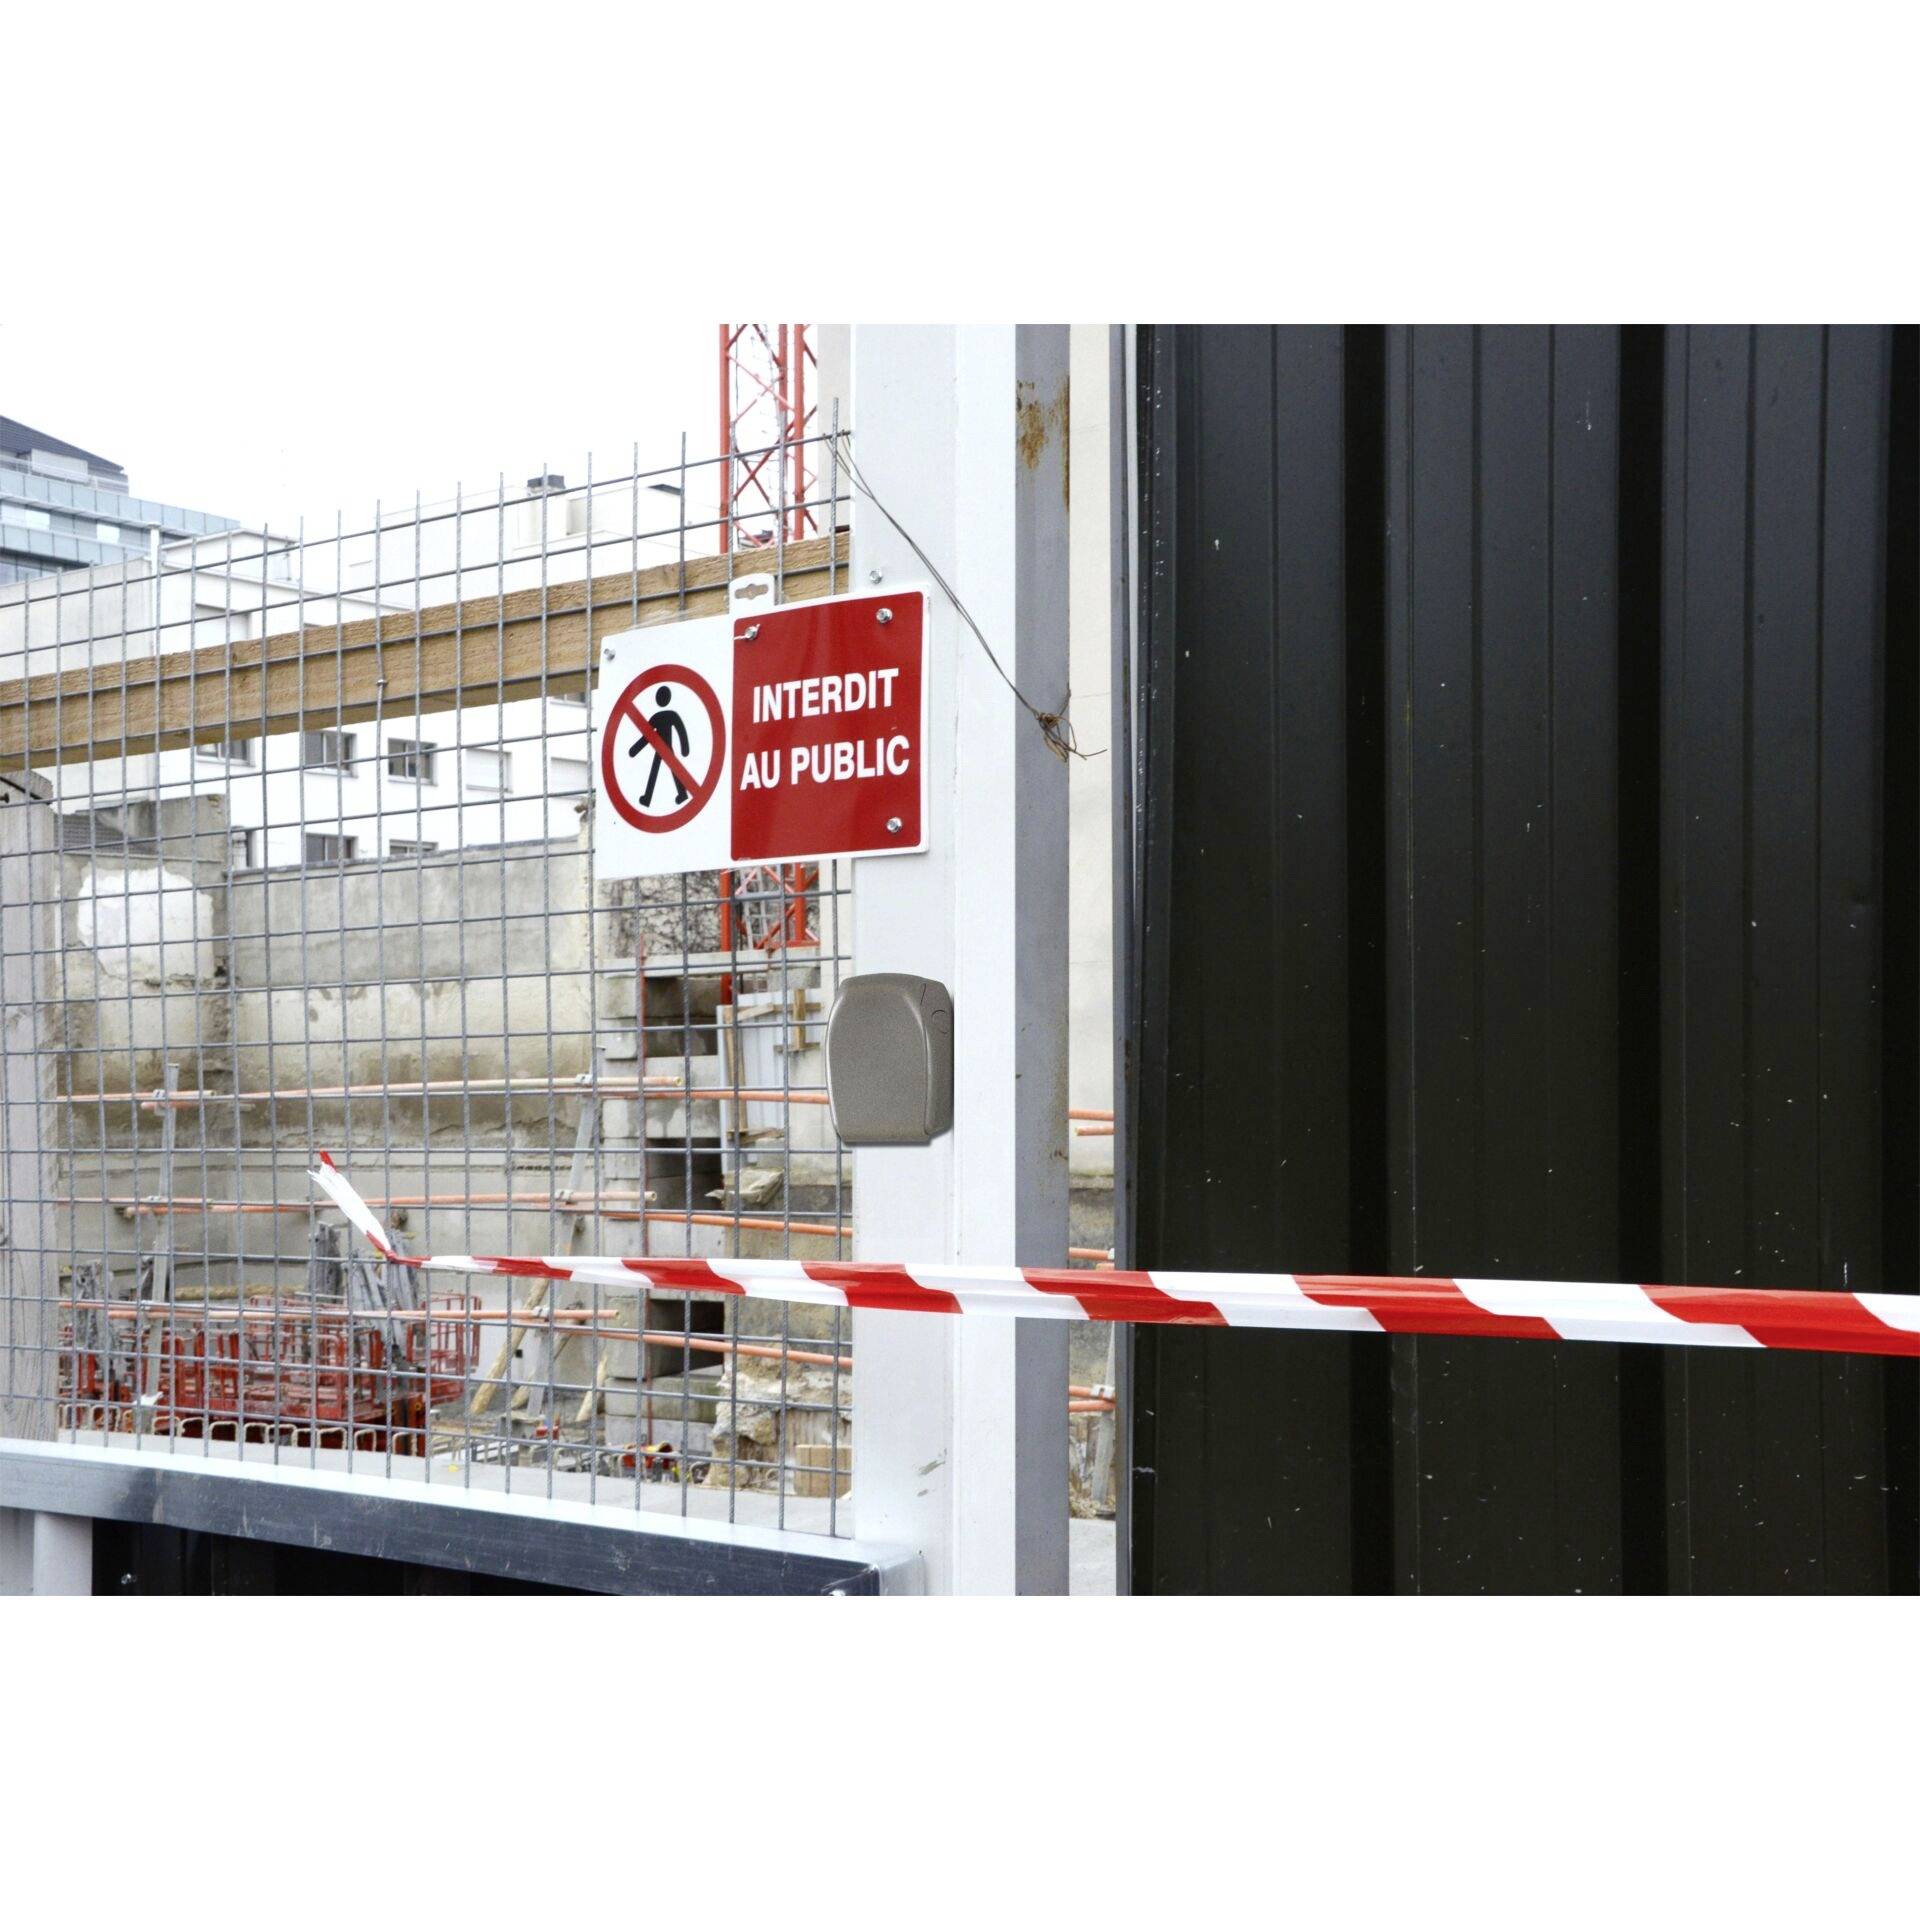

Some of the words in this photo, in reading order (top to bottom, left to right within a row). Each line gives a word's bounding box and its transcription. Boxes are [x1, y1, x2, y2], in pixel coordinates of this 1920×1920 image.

[752, 668, 899, 724] INTERDIT
[739, 749, 781, 791] AU
[790, 735, 910, 785] PUBLIC
